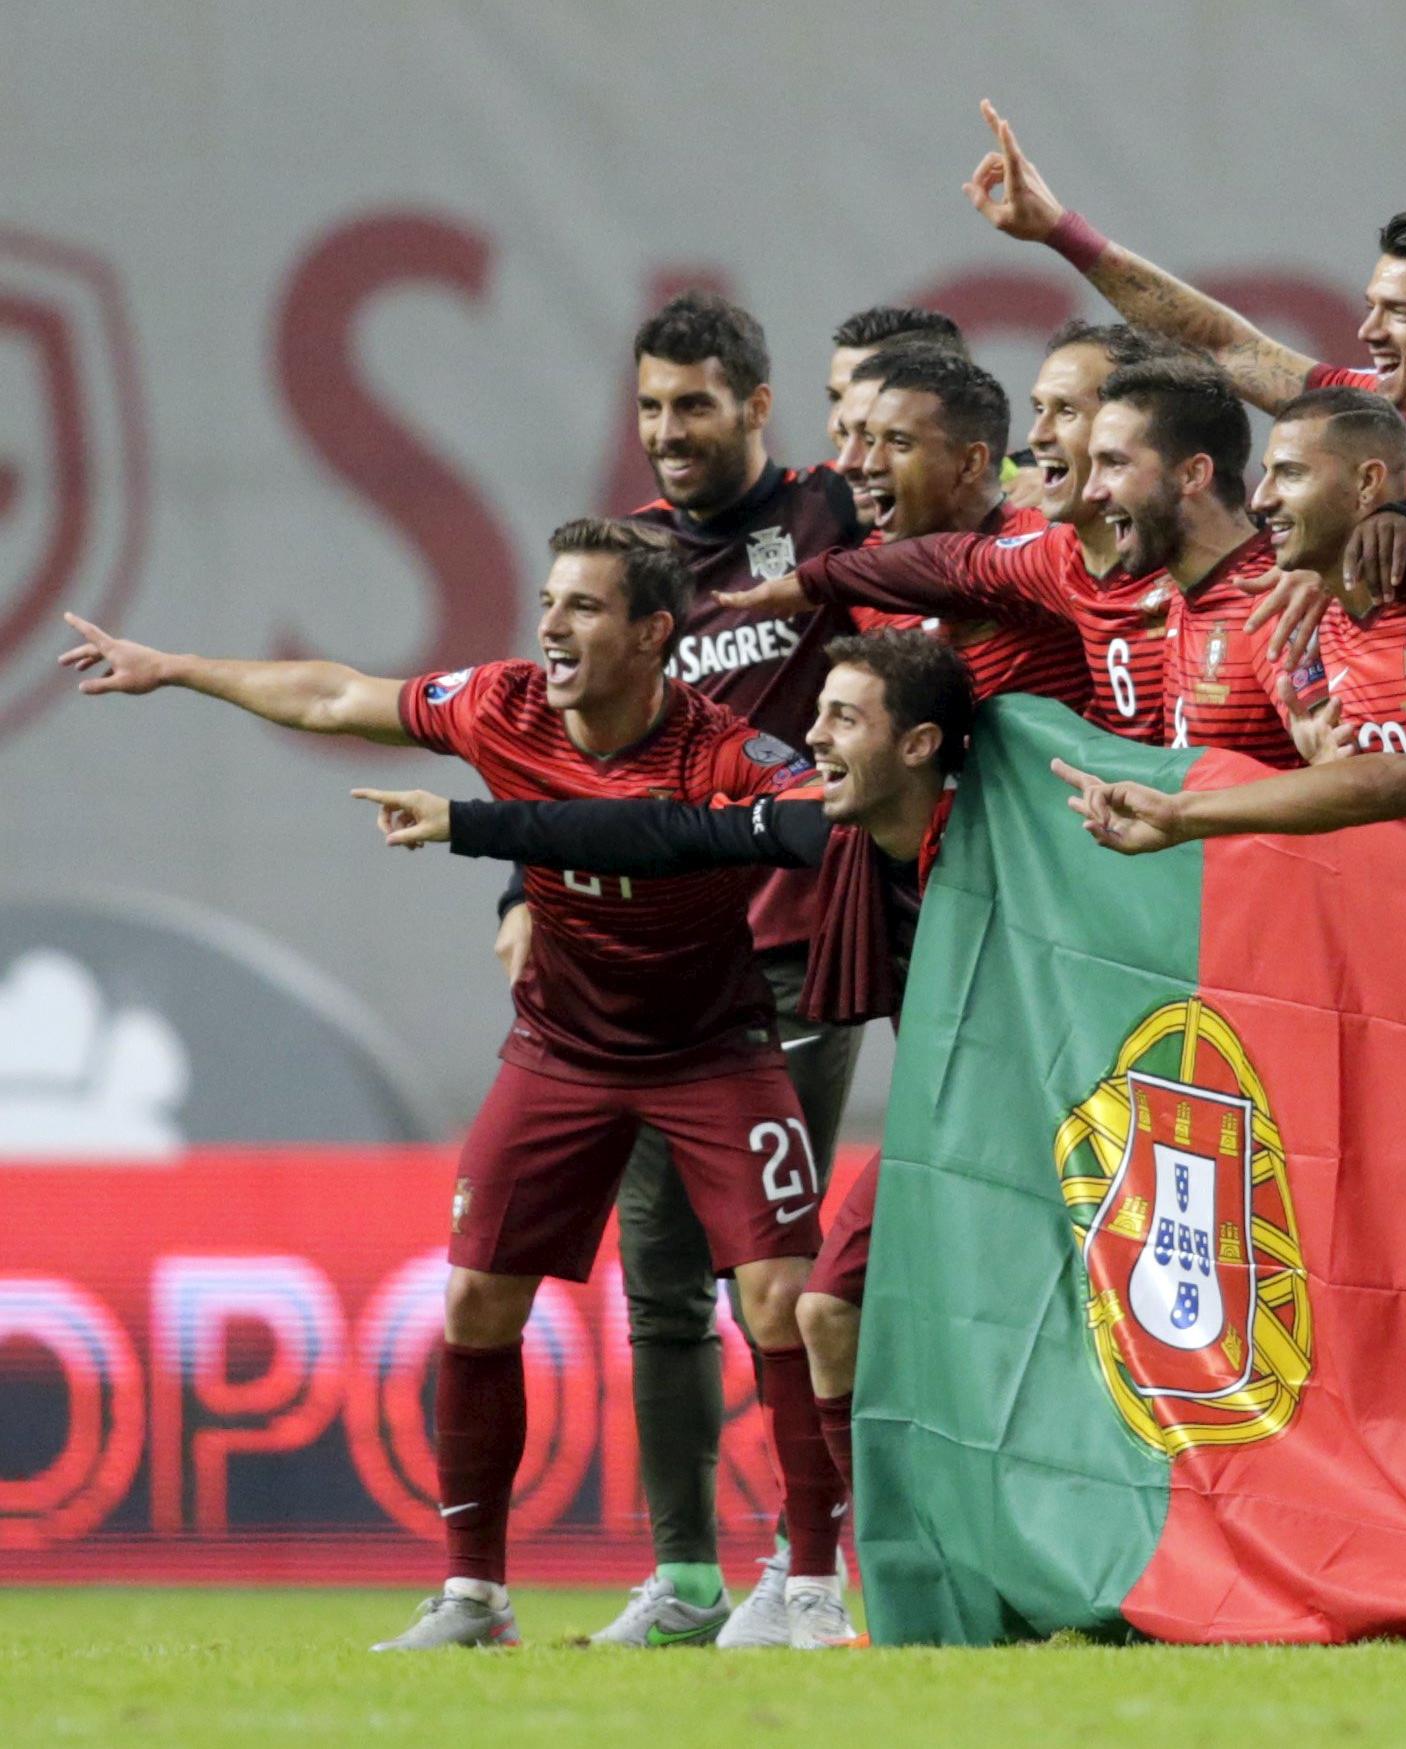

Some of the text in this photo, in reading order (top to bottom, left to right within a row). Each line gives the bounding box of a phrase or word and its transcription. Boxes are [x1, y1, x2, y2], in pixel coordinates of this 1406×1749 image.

[679, 616, 801, 684] SAGRES
[1107, 637, 1136, 718] 6
[749, 1117, 818, 1201] 21
